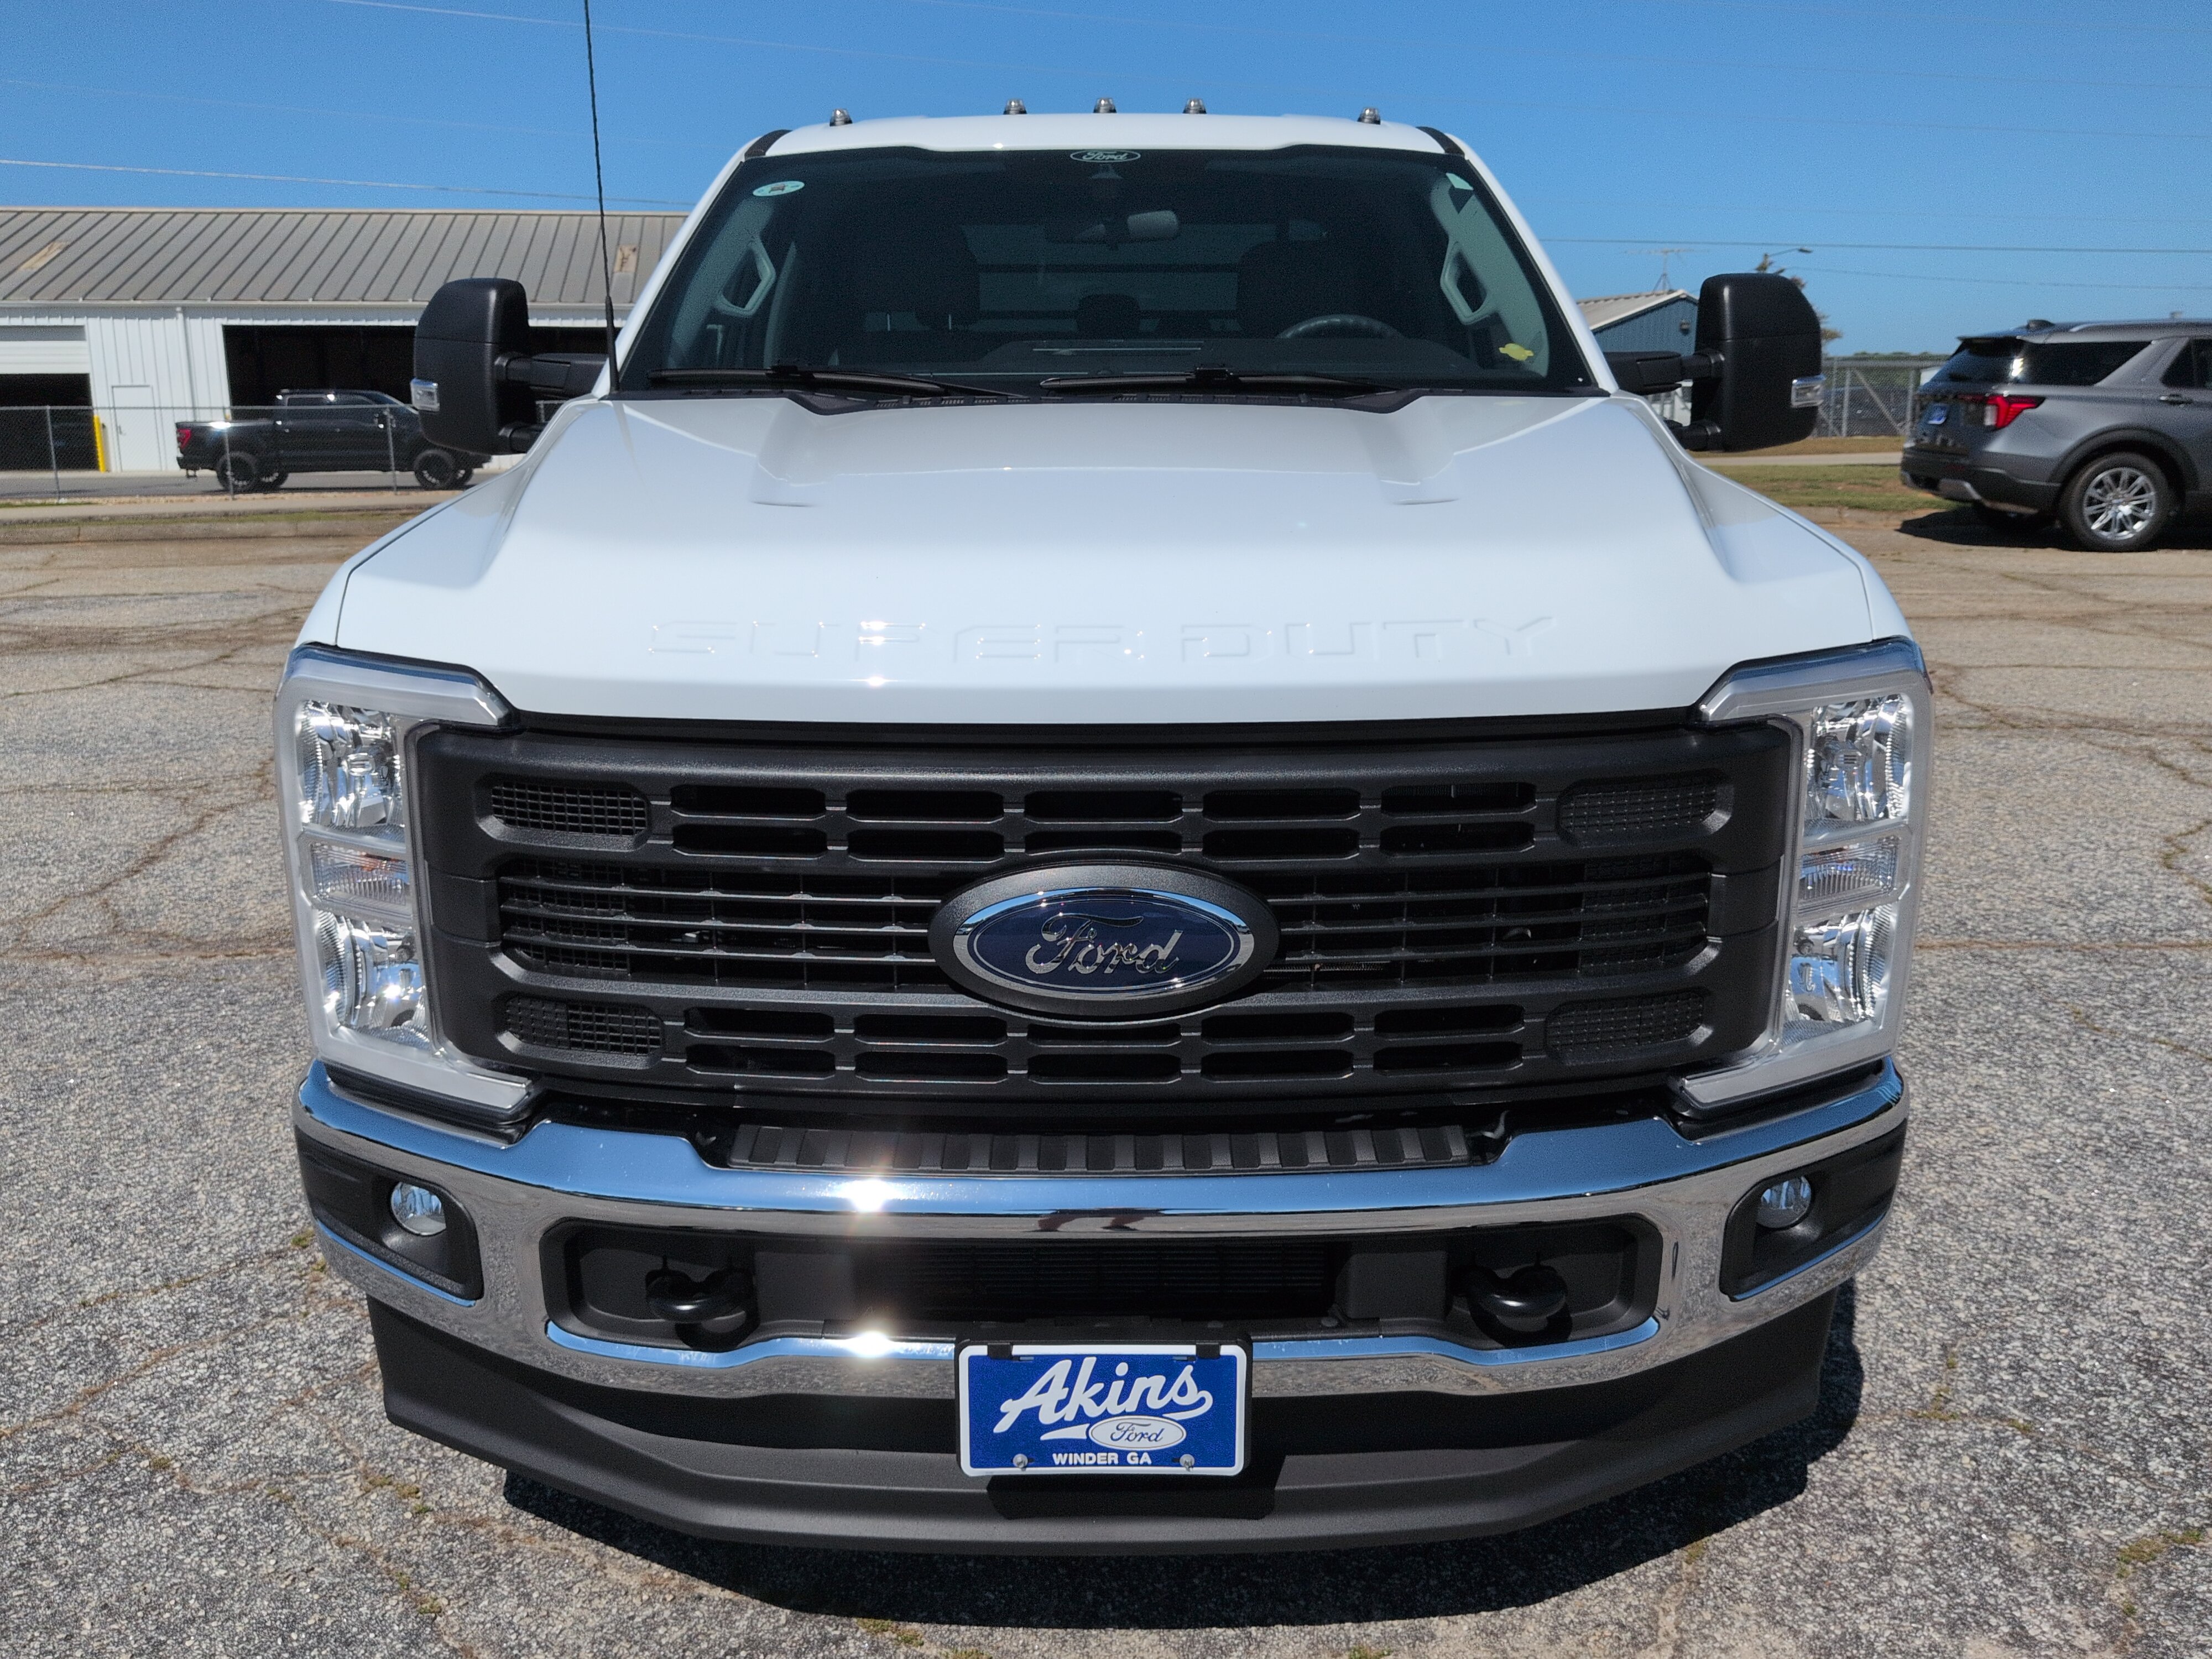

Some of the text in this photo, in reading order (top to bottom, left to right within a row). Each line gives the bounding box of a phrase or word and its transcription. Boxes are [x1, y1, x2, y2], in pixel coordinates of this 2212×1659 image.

[1082, 150, 1129, 160] Ford
[648, 615, 1558, 664] SUPER DUTY
[1025, 912, 1183, 974] Ford
[993, 1356, 1213, 1433] Akins
[1110, 1421, 1164, 1443] Ford
[1052, 1452, 1152, 1465] WINDER GA
